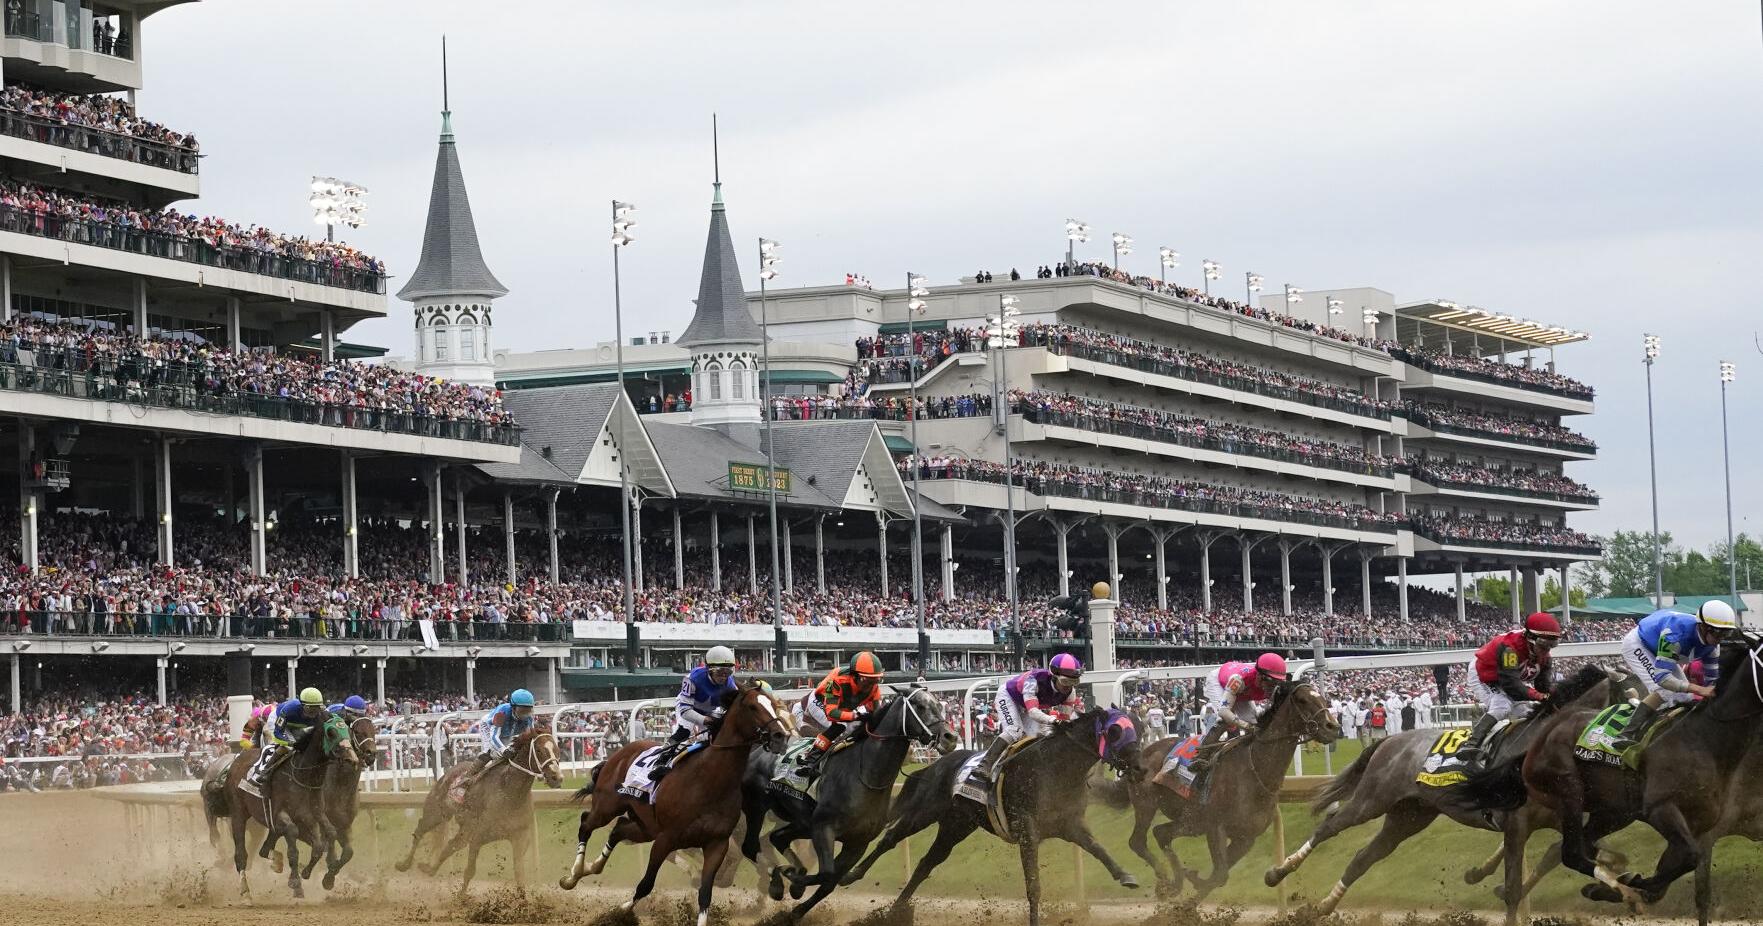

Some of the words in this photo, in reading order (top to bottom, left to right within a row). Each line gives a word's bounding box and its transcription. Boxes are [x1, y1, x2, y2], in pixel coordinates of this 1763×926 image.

[734, 475, 753, 486] 1875
[766, 479, 785, 489] 223
[1503, 652, 1518, 667] 18
[682, 681, 690, 696] 21
[1024, 680, 1036, 693] 22
[1431, 729, 1472, 754] 18
[1605, 753, 1622, 766] ROA
